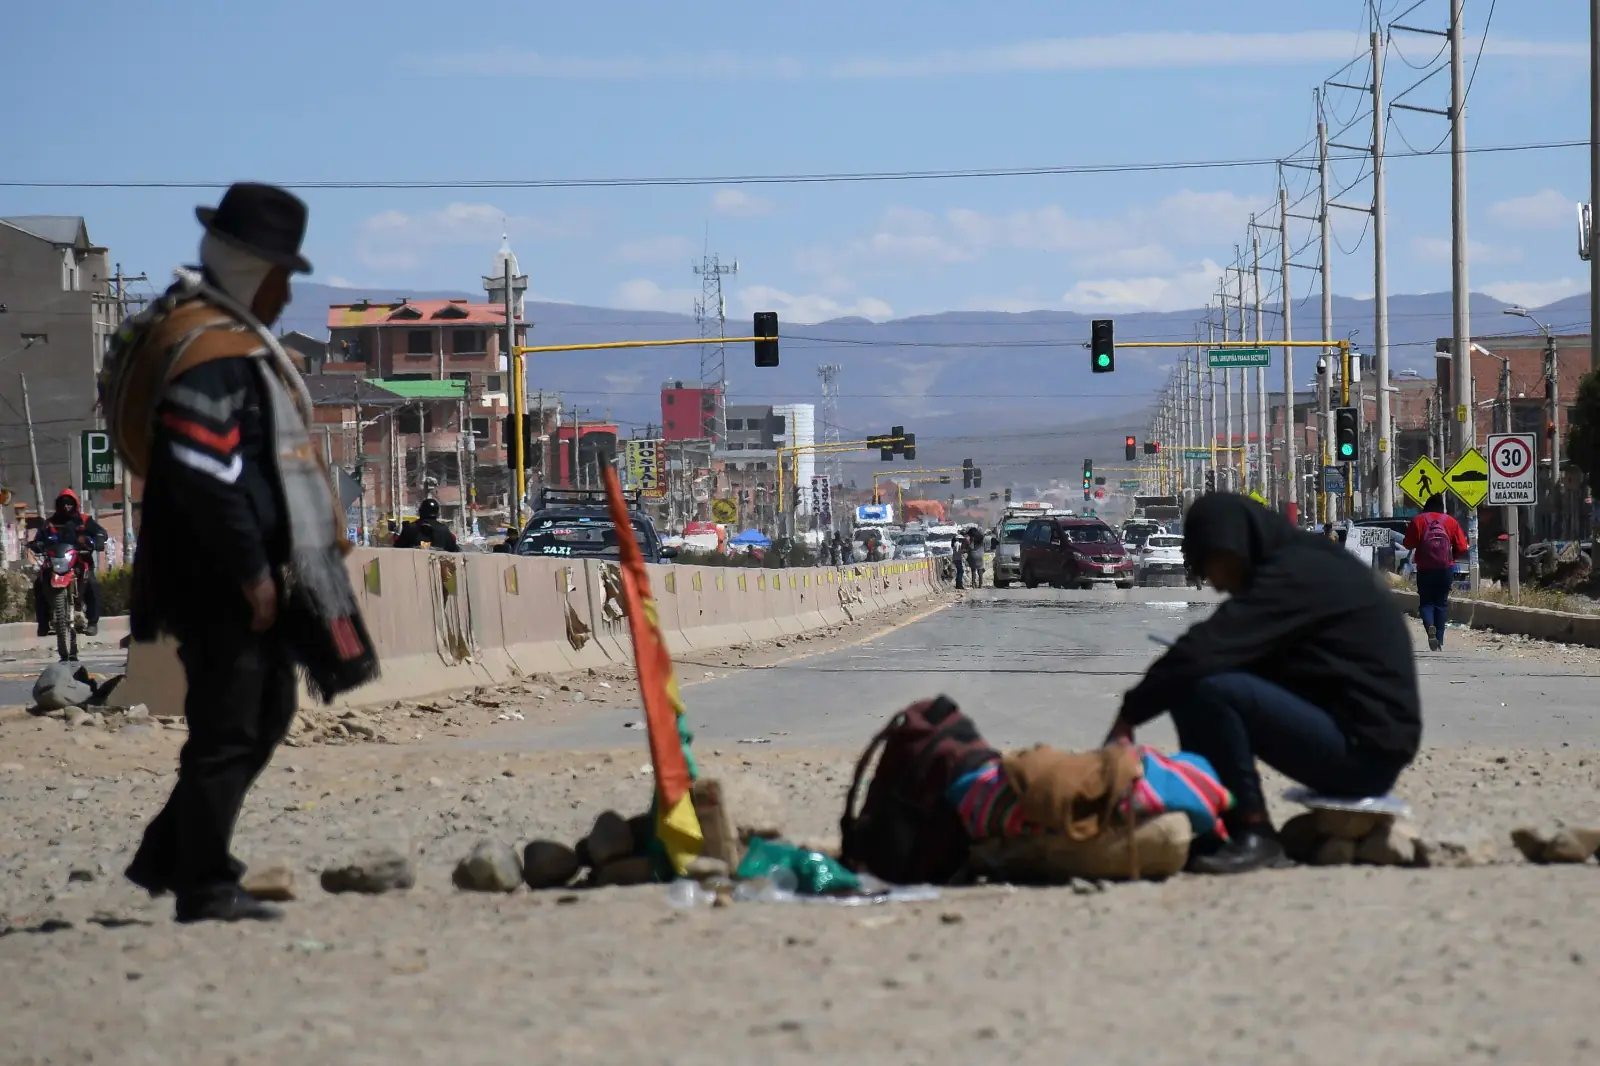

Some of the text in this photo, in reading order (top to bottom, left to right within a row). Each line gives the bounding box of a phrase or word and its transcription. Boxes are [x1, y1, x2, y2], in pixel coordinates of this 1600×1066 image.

[88, 433, 109, 472] P
[1501, 449, 1522, 466] 30
[96, 464, 112, 473] SAN
[639, 441, 656, 488] HOSTAL
[1492, 482, 1533, 490] VELOCIDAD
[1495, 491, 1529, 499] MÁXIMA
[543, 546, 571, 555] TAXI
